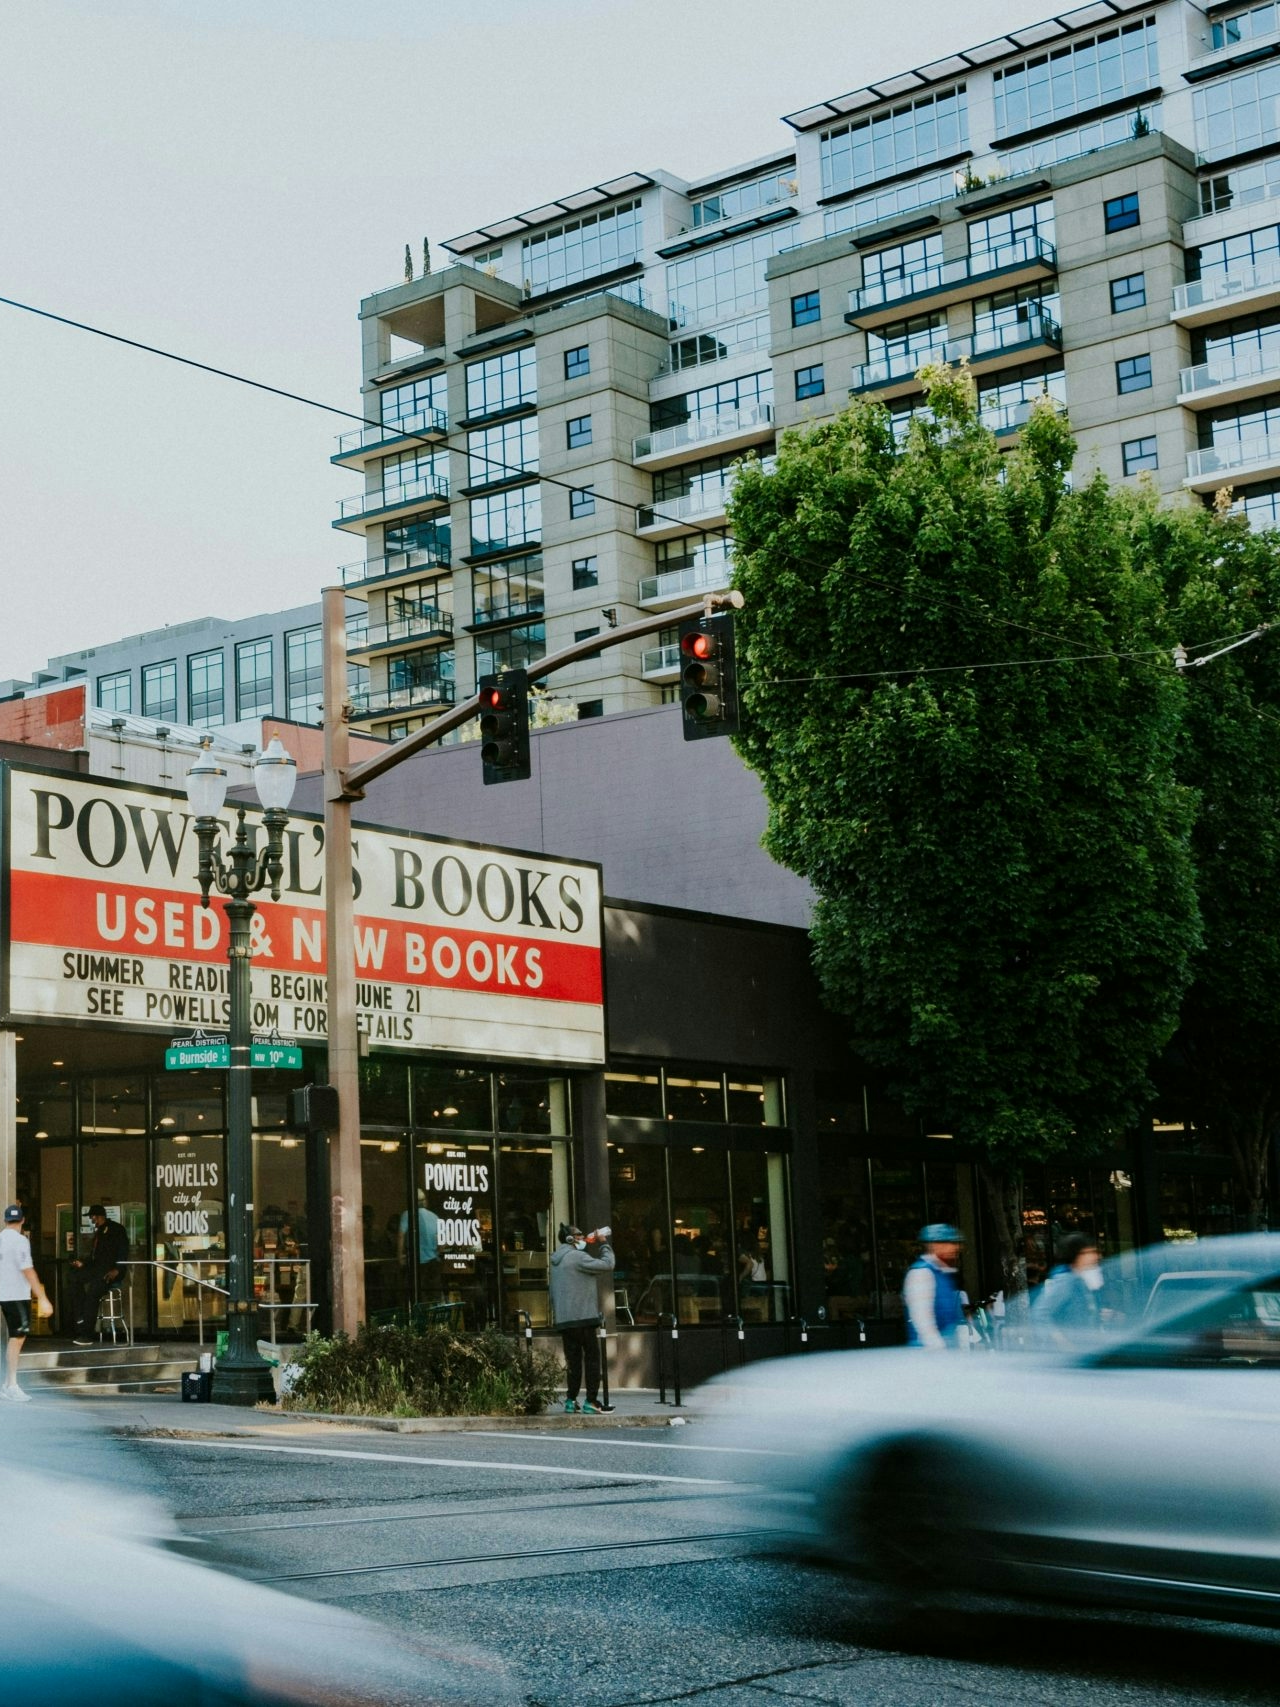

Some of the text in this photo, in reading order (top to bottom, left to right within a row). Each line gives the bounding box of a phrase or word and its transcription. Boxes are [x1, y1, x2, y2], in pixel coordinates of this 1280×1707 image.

[30, 789, 584, 934] POWL' BOOKS
[96, 892, 544, 989] USED & NW BOOKS
[63, 952, 145, 986] SUMMER
[170, 963, 253, 995] READI
[356, 983, 392, 1010] JUNE
[406, 989, 420, 1013] 21
[87, 987, 413, 1041] SEE POWELLSOM FOR ETAILS
[195, 1037, 225, 1046] DISTRICT
[254, 1038, 295, 1047] PEARL DISTRICT
[170, 1056, 177, 1065] W
[179, 1049, 218, 1065] Burnside
[255, 1053, 265, 1062] NW
[269, 1050, 284, 1063] 10th
[156, 1162, 219, 1188] POWELL'S
[424, 1163, 489, 1192] POWELL'S
[173, 1190, 202, 1207] city of
[443, 1196, 473, 1215] city of
[166, 1210, 209, 1235] BOOKS
[437, 1218, 481, 1246] BOOKS
